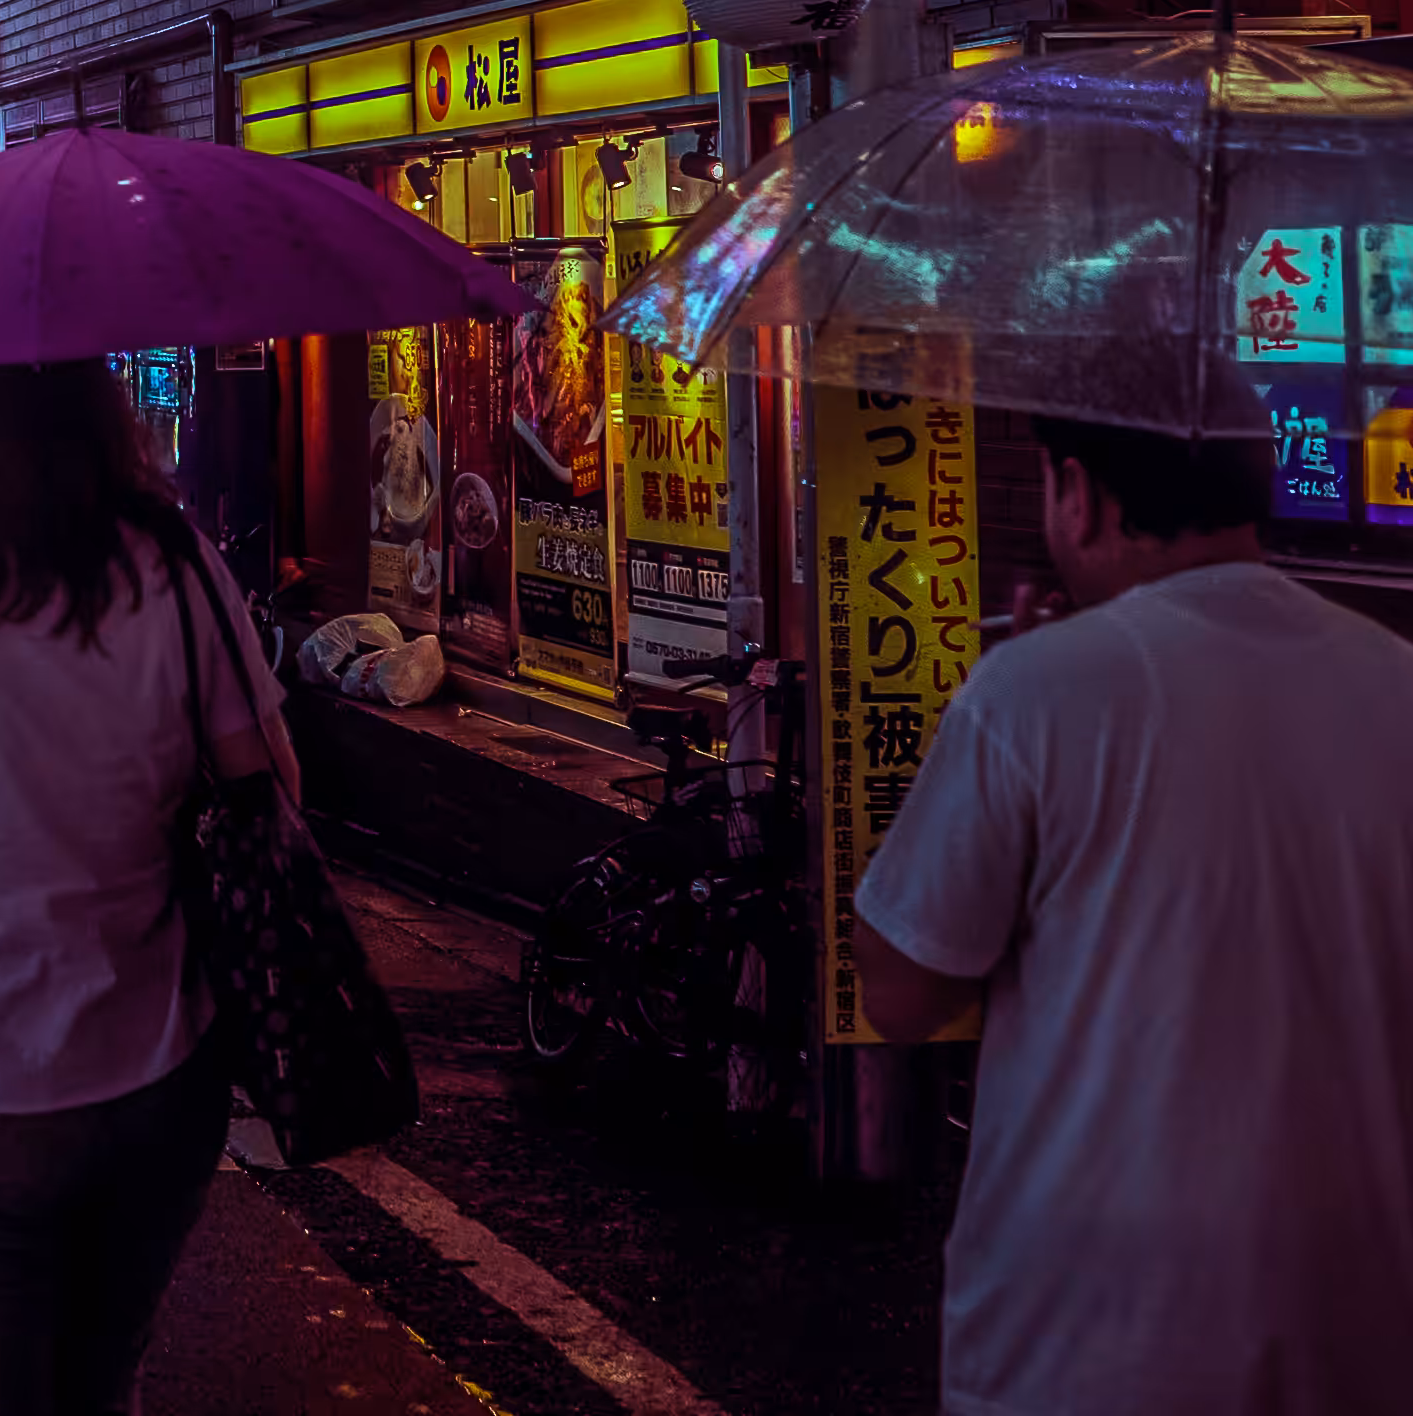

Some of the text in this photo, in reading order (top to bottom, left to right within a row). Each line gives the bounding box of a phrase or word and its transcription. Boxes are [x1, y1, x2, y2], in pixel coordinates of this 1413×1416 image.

[464, 35, 522, 112] 松屋
[1246, 238, 1311, 355] 大陸
[628, 414, 723, 465] アルバイト
[641, 469, 713, 527] 募集中
[536, 535, 605, 582] 生姜焼定食
